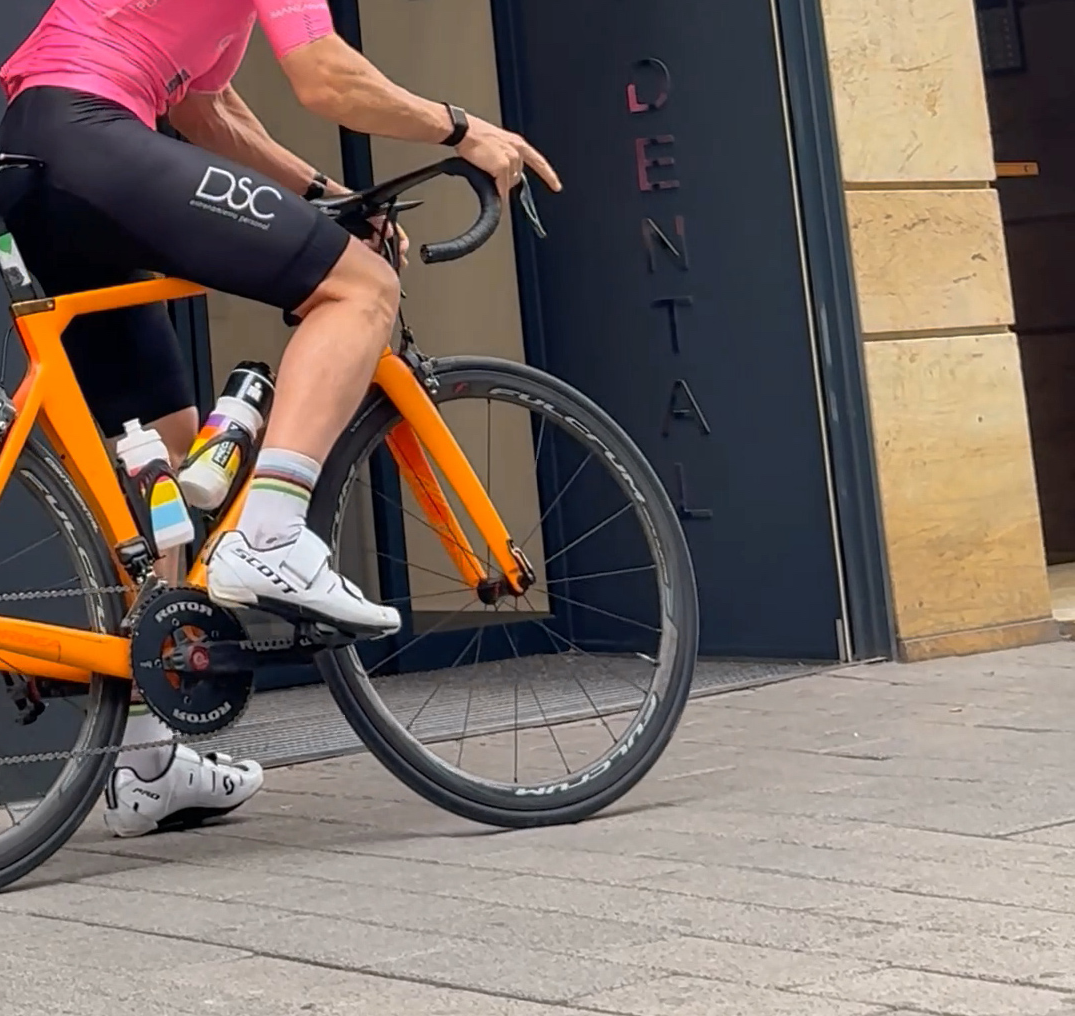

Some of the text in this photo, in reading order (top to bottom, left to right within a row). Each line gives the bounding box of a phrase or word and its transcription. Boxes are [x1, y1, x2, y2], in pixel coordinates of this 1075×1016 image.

[195, 165, 283, 219] DSC
[626, 57, 714, 521] DENTAL
[488, 387, 646, 504] FULCRUM
[230, 547, 298, 595] SCOTT
[154, 601, 214, 623] ROTOR
[172, 701, 232, 723] ROTOR
[132, 787, 161, 801] PRO
